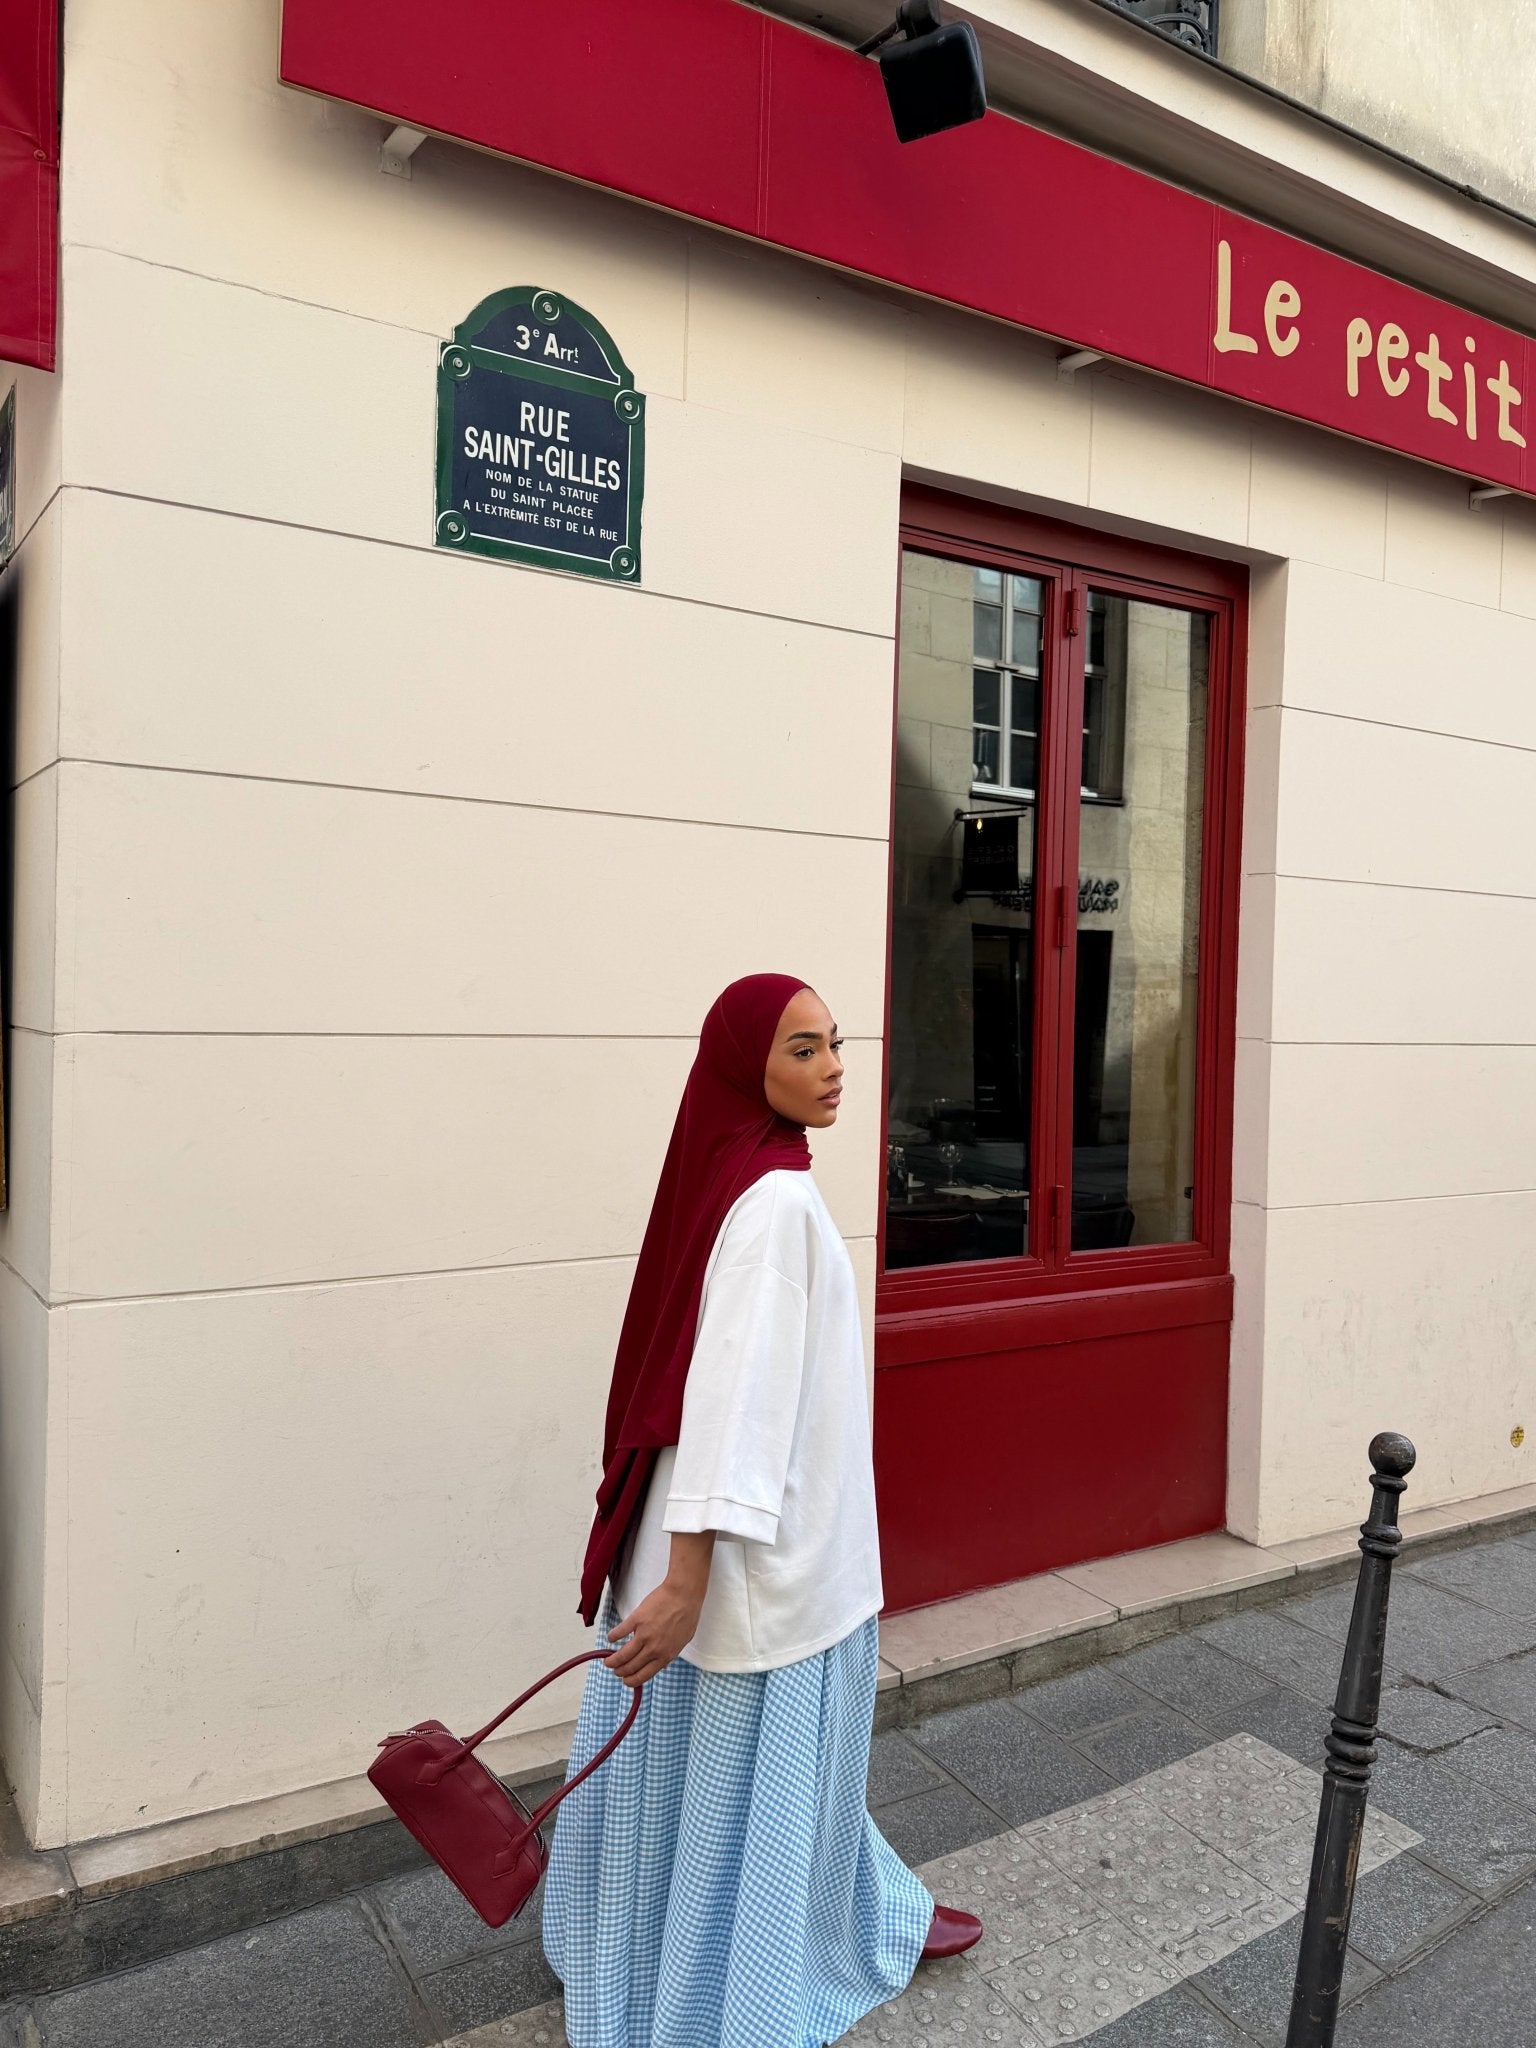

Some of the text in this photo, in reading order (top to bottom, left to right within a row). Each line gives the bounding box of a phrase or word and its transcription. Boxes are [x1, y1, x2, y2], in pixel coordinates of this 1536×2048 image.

[515, 324, 579, 364] 3e Arrt
[1213, 239, 1527, 449] Le petit
[520, 401, 570, 443] RUE
[463, 426, 621, 491] SAINT-GILLES
[485, 468, 599, 504] NOM DE LA STATUE
[490, 487, 594, 520] DU SAINT PLACÉE
[475, 501, 540, 525] L'EXTRÉMITÉ
[543, 516, 562, 529] EST
[566, 521, 579, 533] DE
[583, 525, 596, 537] LA
[599, 528, 618, 542] RUE
